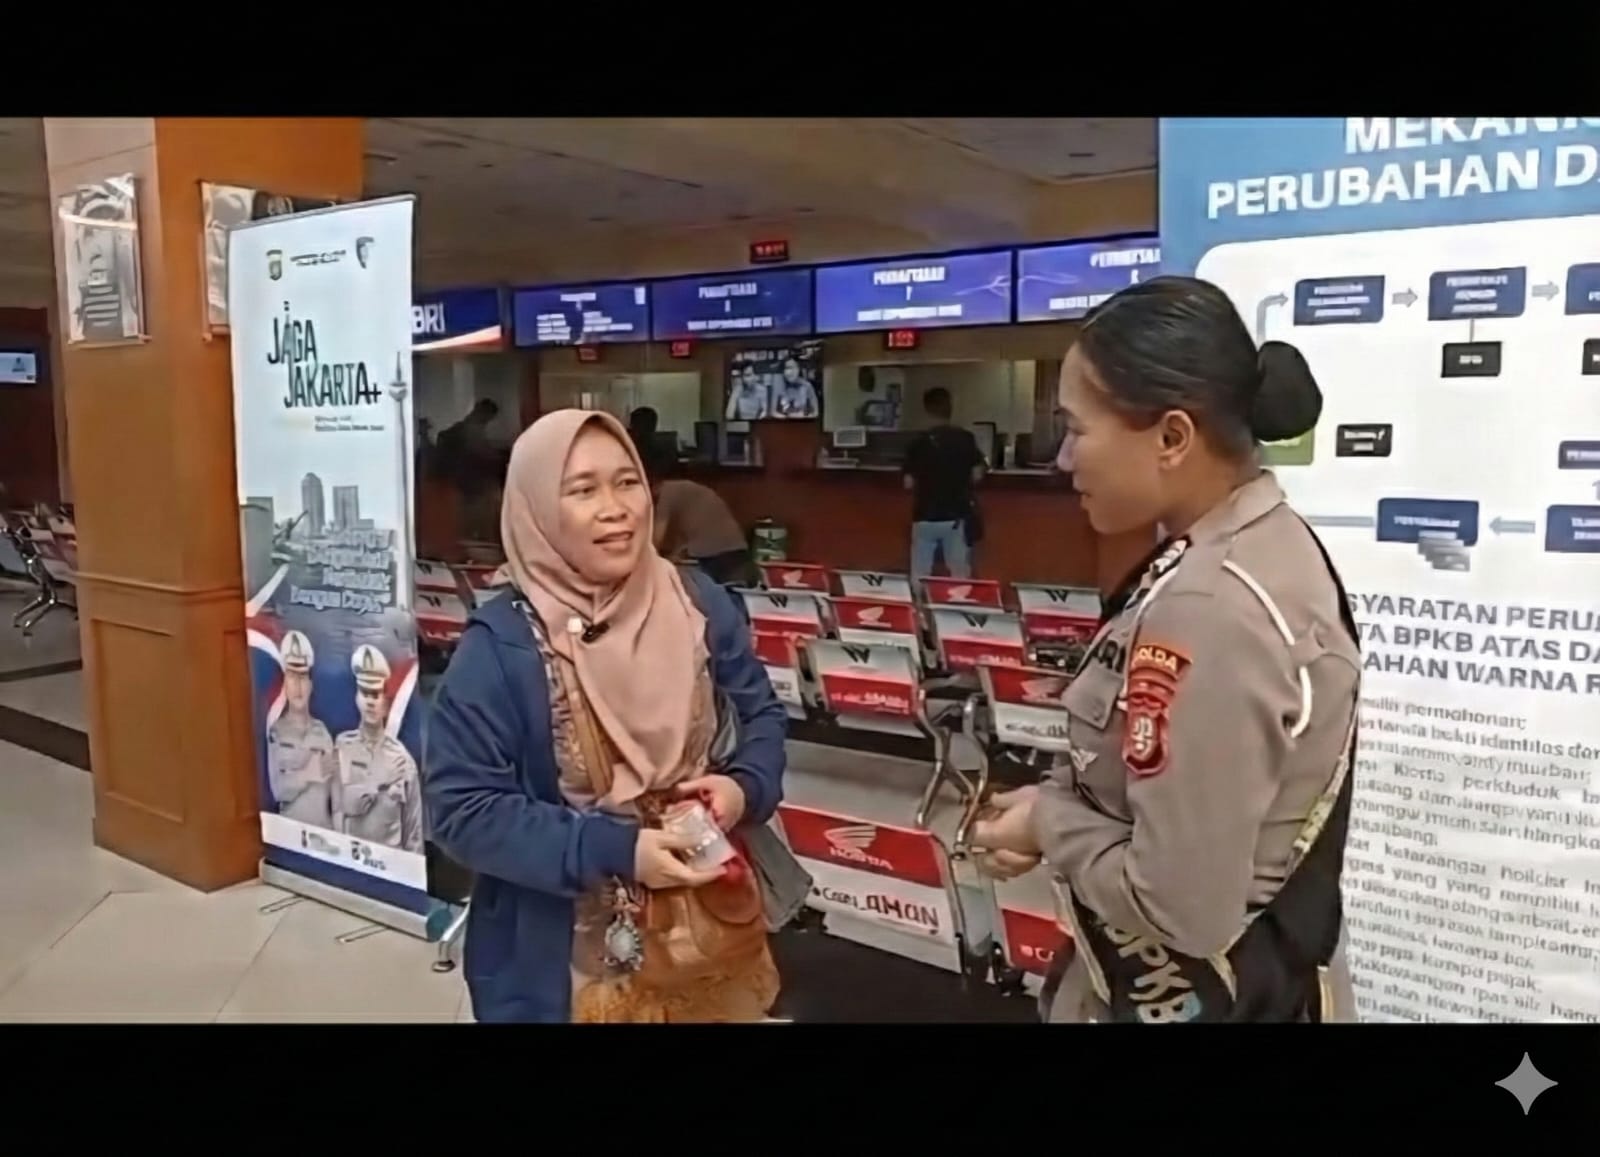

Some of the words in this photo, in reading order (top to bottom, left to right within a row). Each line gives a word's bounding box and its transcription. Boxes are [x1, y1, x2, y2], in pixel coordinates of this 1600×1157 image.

[1208, 149, 1540, 219] PERUBAHAN
[411, 302, 446, 334] BRI
[267, 316, 318, 364] JAGA
[1506, 606, 1600, 633] PERU
[1394, 625, 1473, 653] BPKB
[1479, 635, 1561, 661] ATAS
[1456, 661, 1578, 694] WARNA
